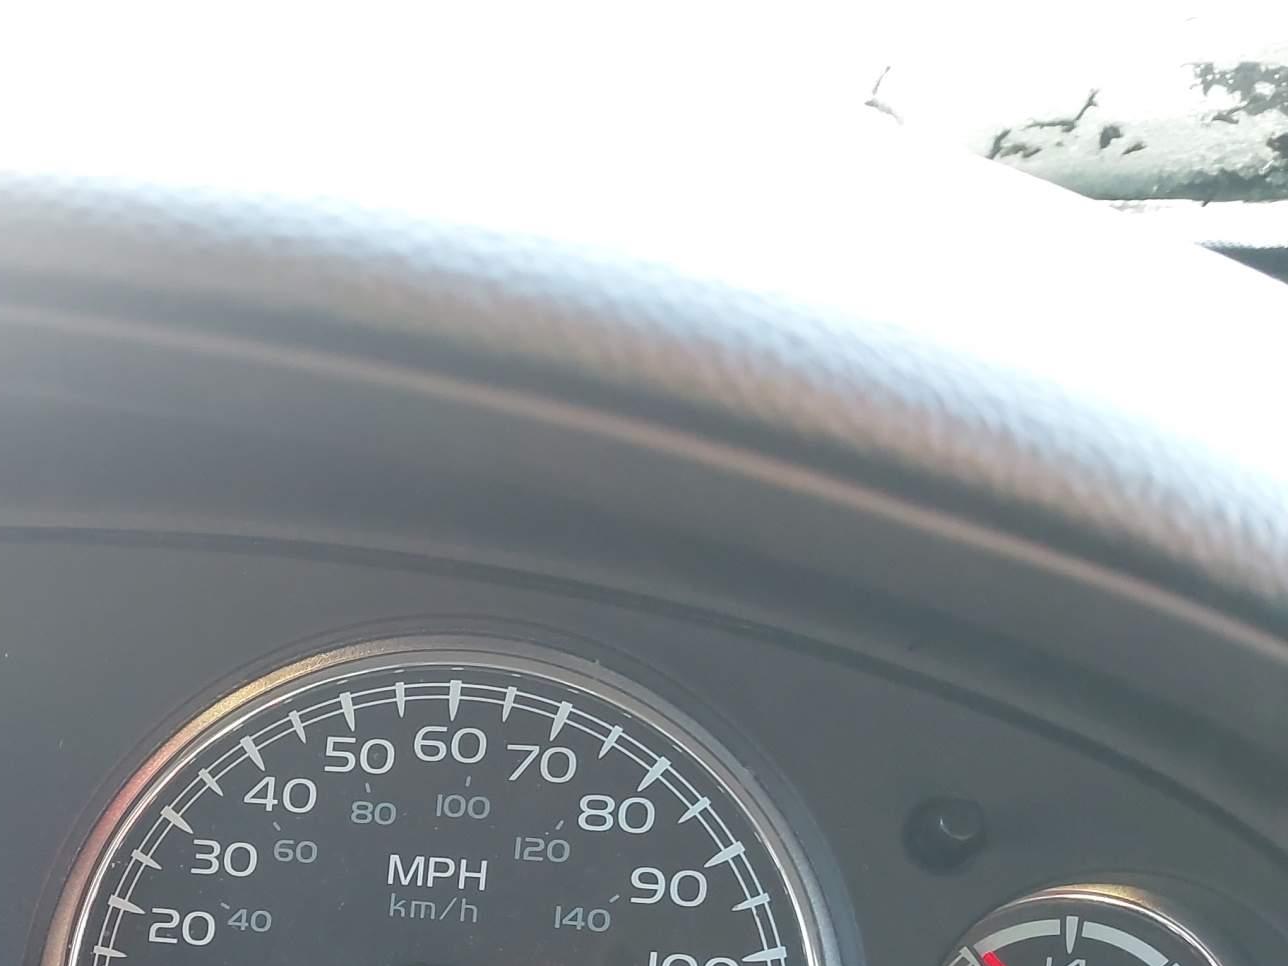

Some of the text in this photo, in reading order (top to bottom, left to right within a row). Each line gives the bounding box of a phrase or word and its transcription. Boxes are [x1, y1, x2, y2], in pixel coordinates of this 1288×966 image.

[324, 736, 395, 774] 50
[413, 726, 487, 763] 60
[506, 744, 577, 783] 70
[243, 776, 318, 813] 40
[350, 801, 397, 825] 80
[435, 793, 491, 819] 100
[577, 794, 655, 833] 80
[190, 839, 258, 877] 30
[273, 839, 318, 863] 60
[513, 836, 571, 862] 120
[386, 854, 488, 891] MPH
[629, 867, 707, 907] 90
[148, 907, 216, 946] 20
[227, 909, 272, 932] 40
[388, 893, 479, 923] km/h
[553, 905, 611, 932] 140
